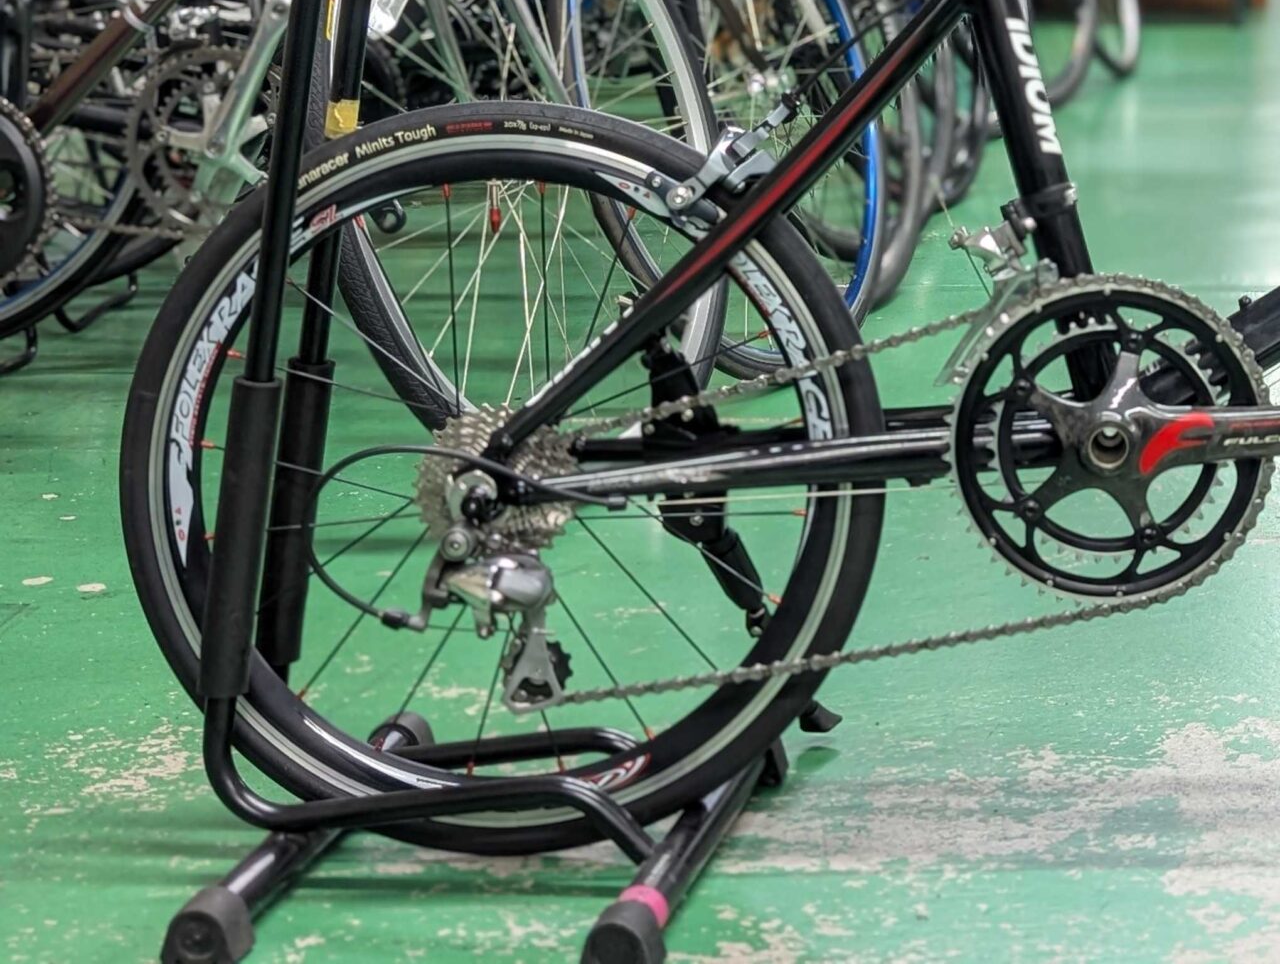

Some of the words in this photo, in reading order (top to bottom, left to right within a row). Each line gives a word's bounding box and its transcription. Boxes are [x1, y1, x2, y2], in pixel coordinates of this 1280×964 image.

[1005, 17, 1063, 154] IDIOM
[298, 151, 350, 189] naracer
[355, 133, 395, 159] Minits
[397, 123, 437, 146] Tough
